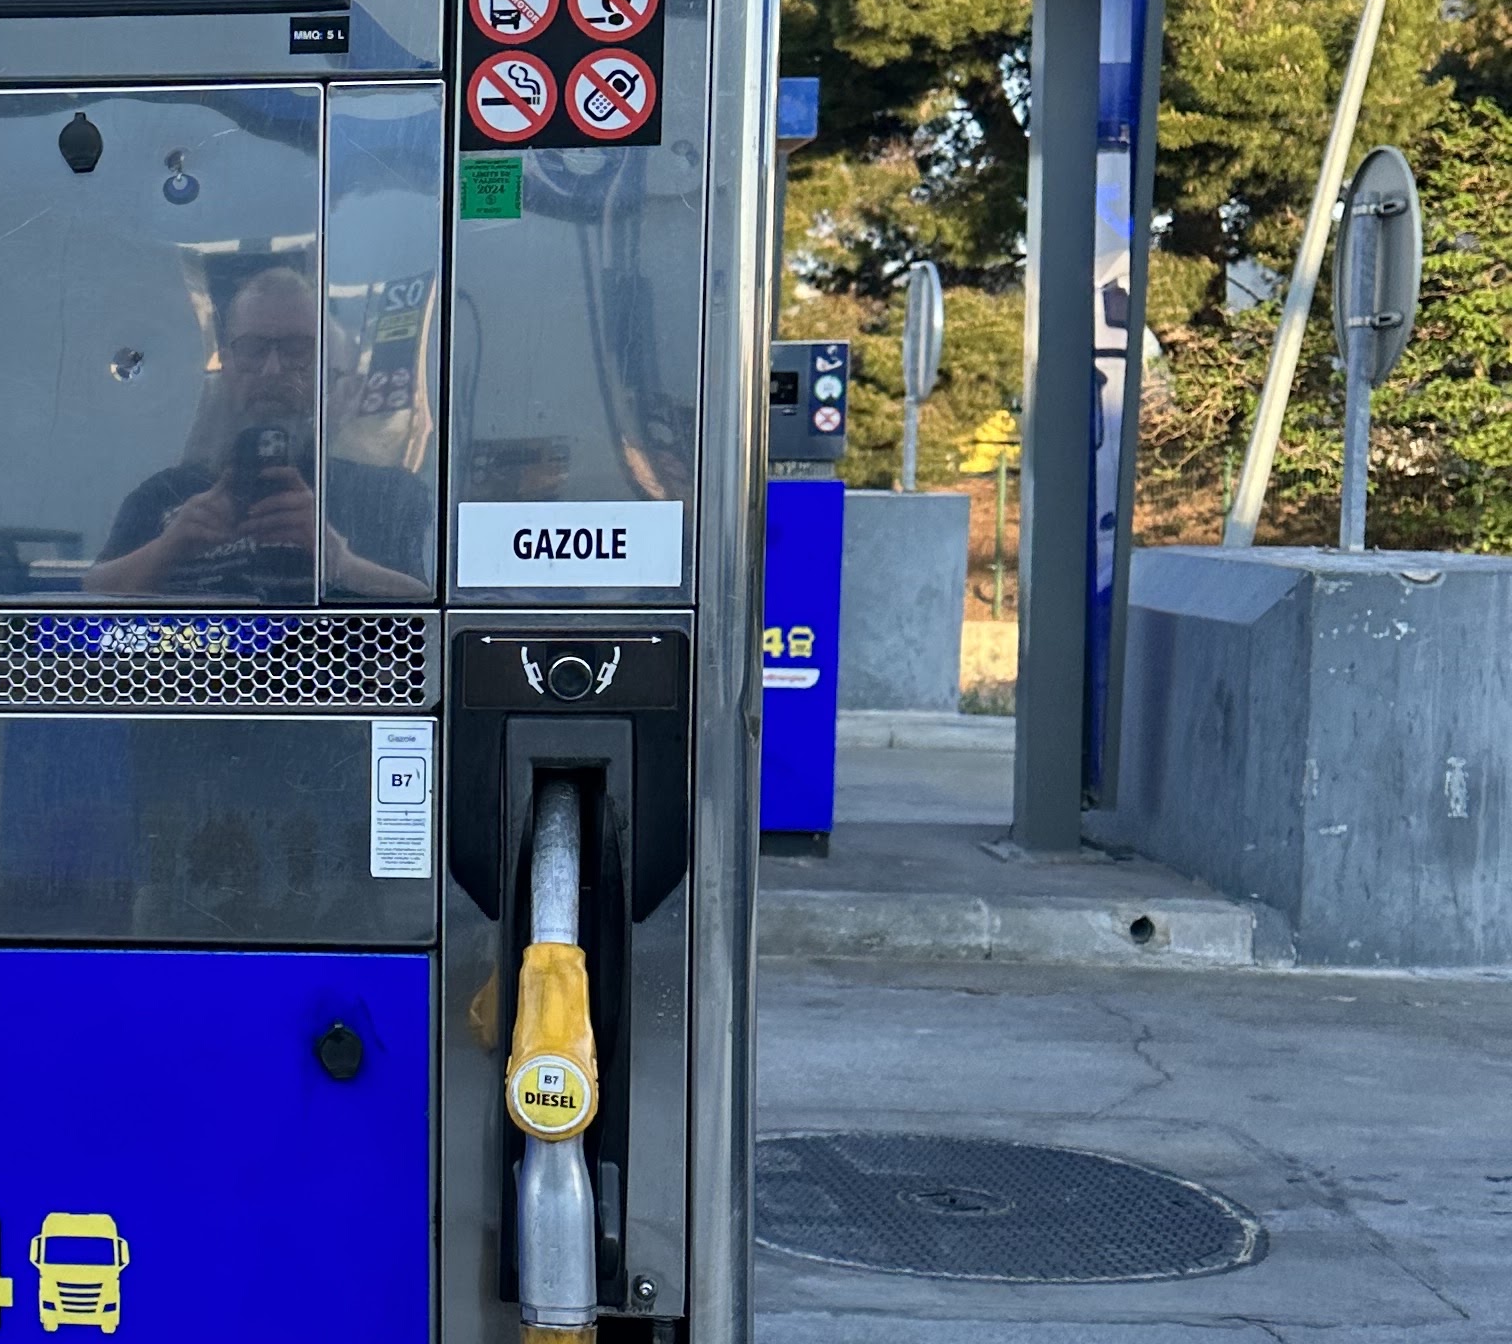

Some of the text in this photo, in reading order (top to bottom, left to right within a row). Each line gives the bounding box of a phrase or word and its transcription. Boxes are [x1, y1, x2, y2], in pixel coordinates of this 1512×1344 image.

[326, 29, 335, 40] 5
[337, 29, 345, 40] L
[513, 527, 627, 560] GAZOLE
[387, 734, 416, 743] Gazole
[391, 773, 413, 787] B7
[544, 1074, 559, 1085] B7
[525, 1091, 576, 1109] DIESEL
